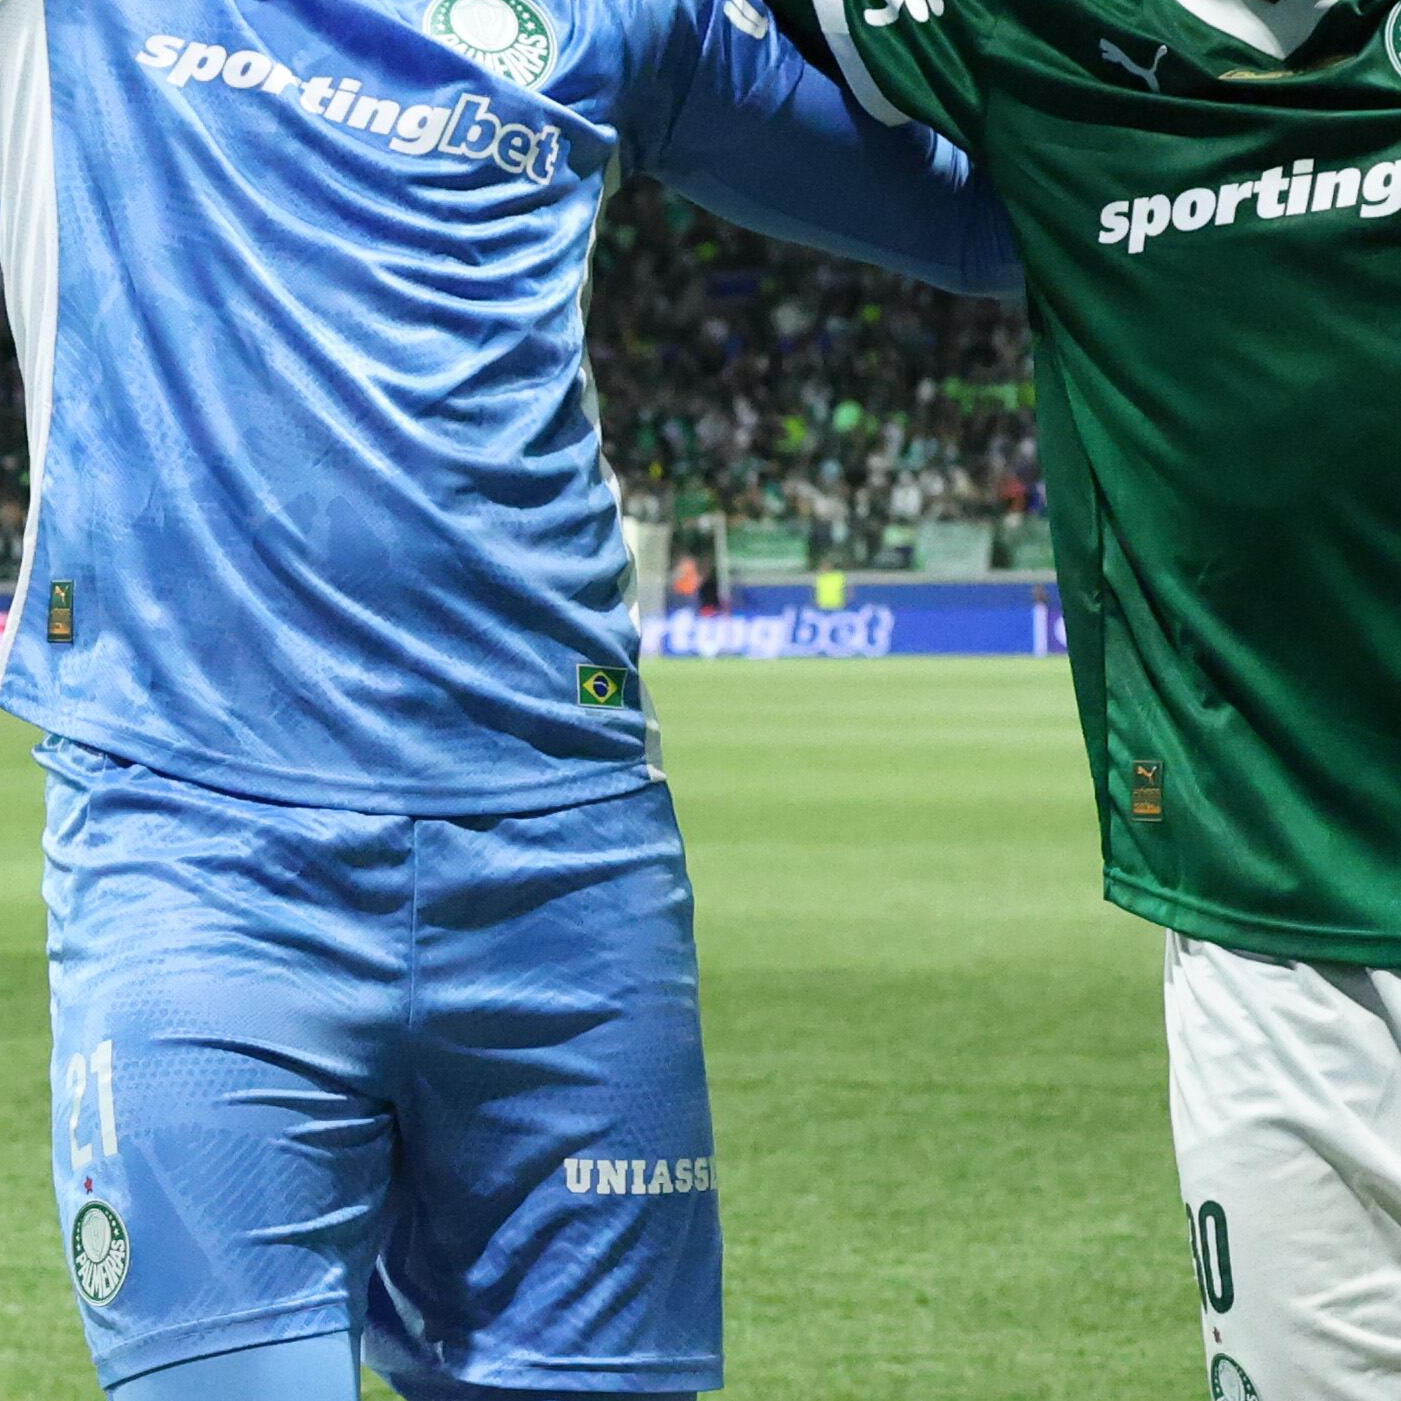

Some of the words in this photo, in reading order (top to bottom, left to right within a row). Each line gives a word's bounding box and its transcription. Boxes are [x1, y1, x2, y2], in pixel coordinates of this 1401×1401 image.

[136, 34, 568, 185] sportingbet
[434, 32, 550, 88] PAEIRAS
[65, 1038, 119, 1171] 21
[75, 1239, 125, 1297] PALMEIRAS
[1185, 1199, 1235, 1316] 0
